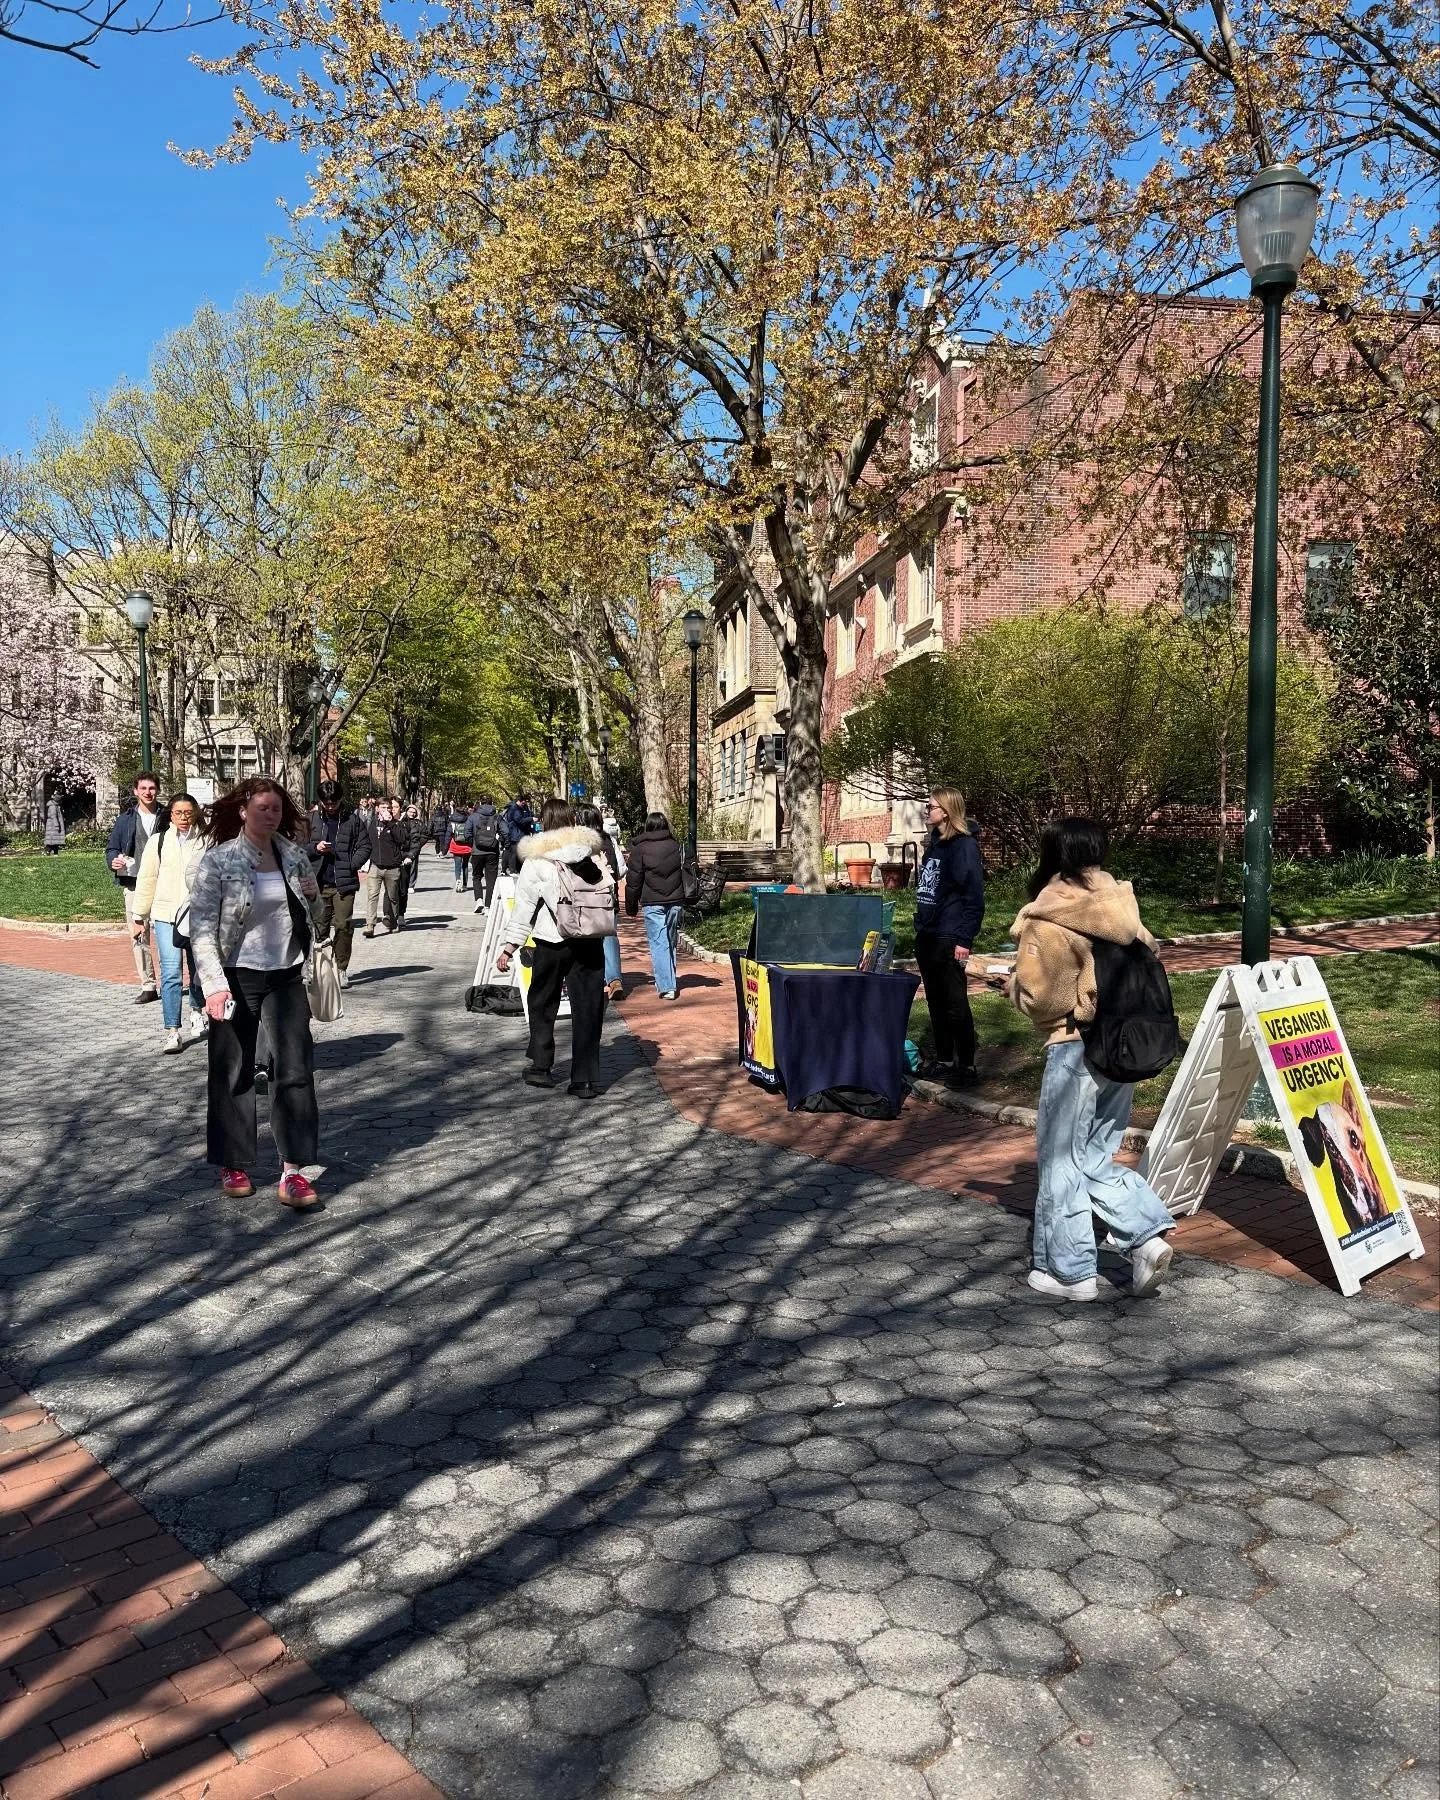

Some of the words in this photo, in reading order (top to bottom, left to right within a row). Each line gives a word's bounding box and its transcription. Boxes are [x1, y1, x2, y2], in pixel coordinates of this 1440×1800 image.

[1265, 1009, 1331, 1040] VEGANISM
[1281, 1046, 1293, 1063] IS
[1293, 1045, 1302, 1060] A
[1301, 1036, 1335, 1059] MORAL
[1283, 1056, 1347, 1092] URGENCY
